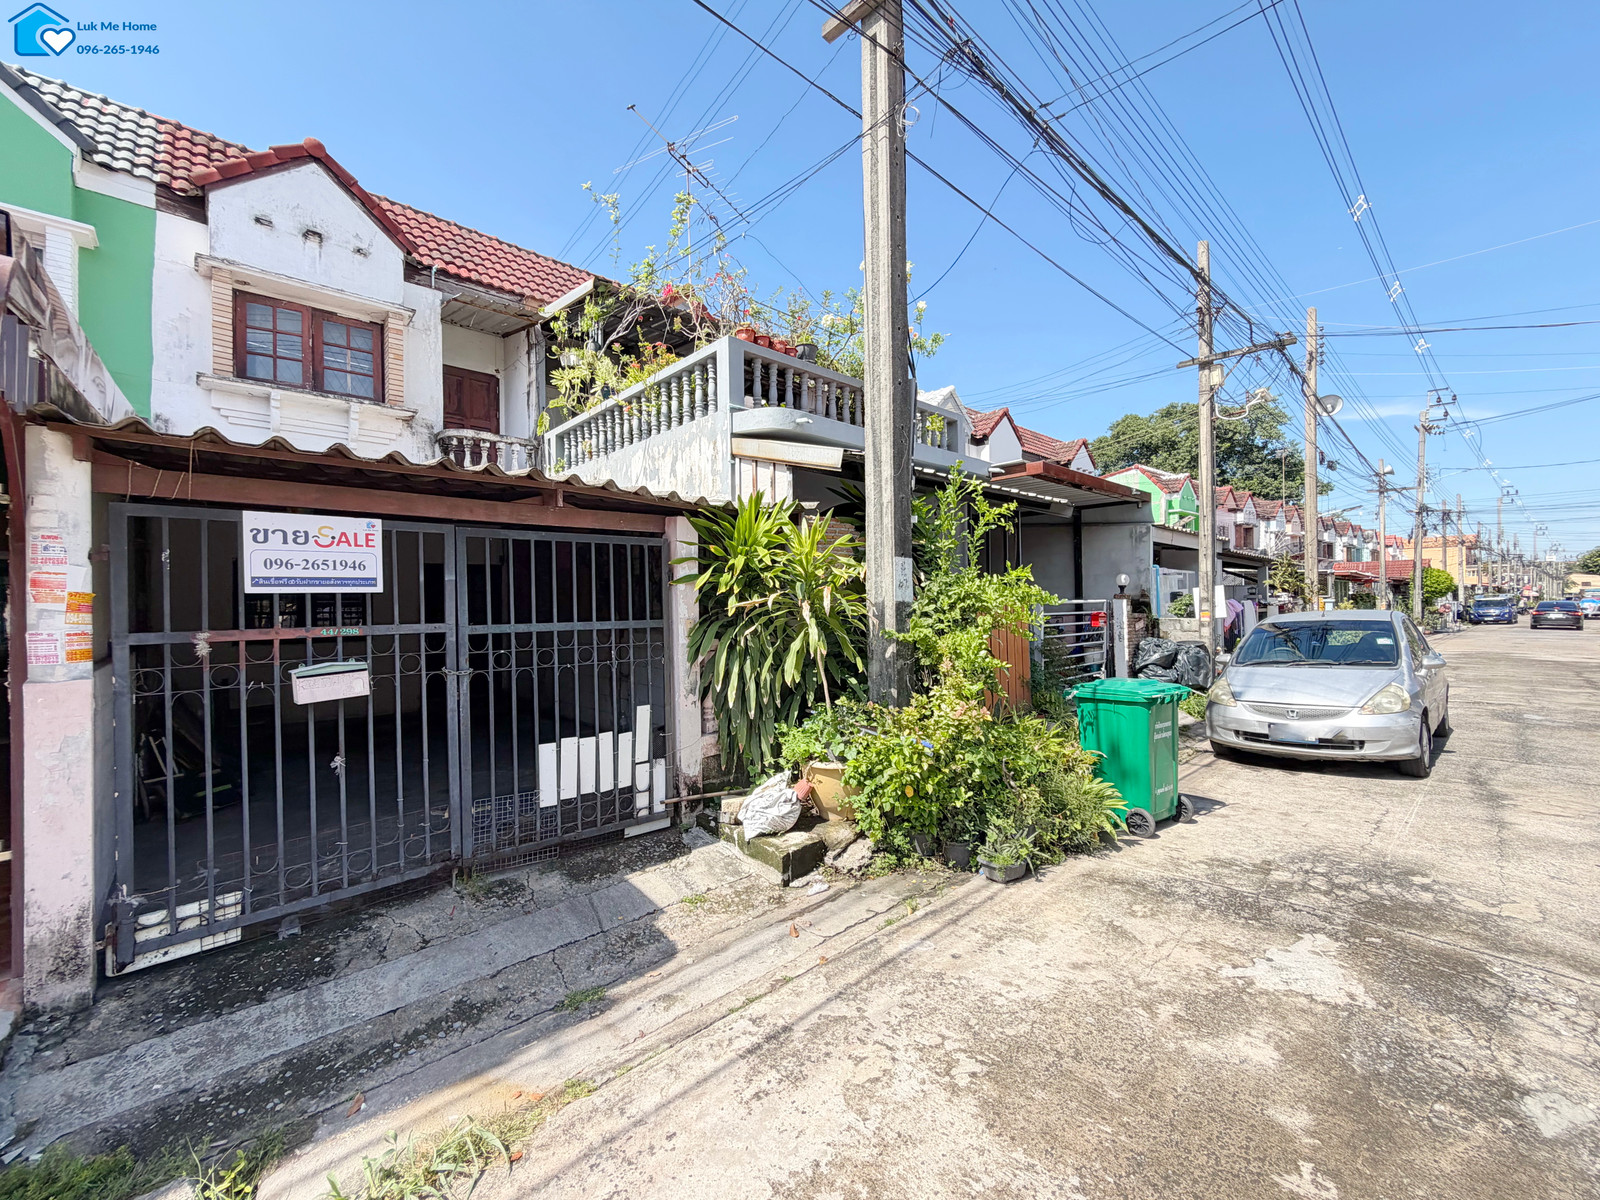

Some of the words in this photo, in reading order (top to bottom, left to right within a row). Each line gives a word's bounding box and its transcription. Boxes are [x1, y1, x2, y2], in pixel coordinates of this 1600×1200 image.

[250, 527, 310, 546] ขาย
[312, 525, 376, 548] SALE
[263, 557, 367, 571] 096-2651946
[320, 628, 360, 636] 44/298
